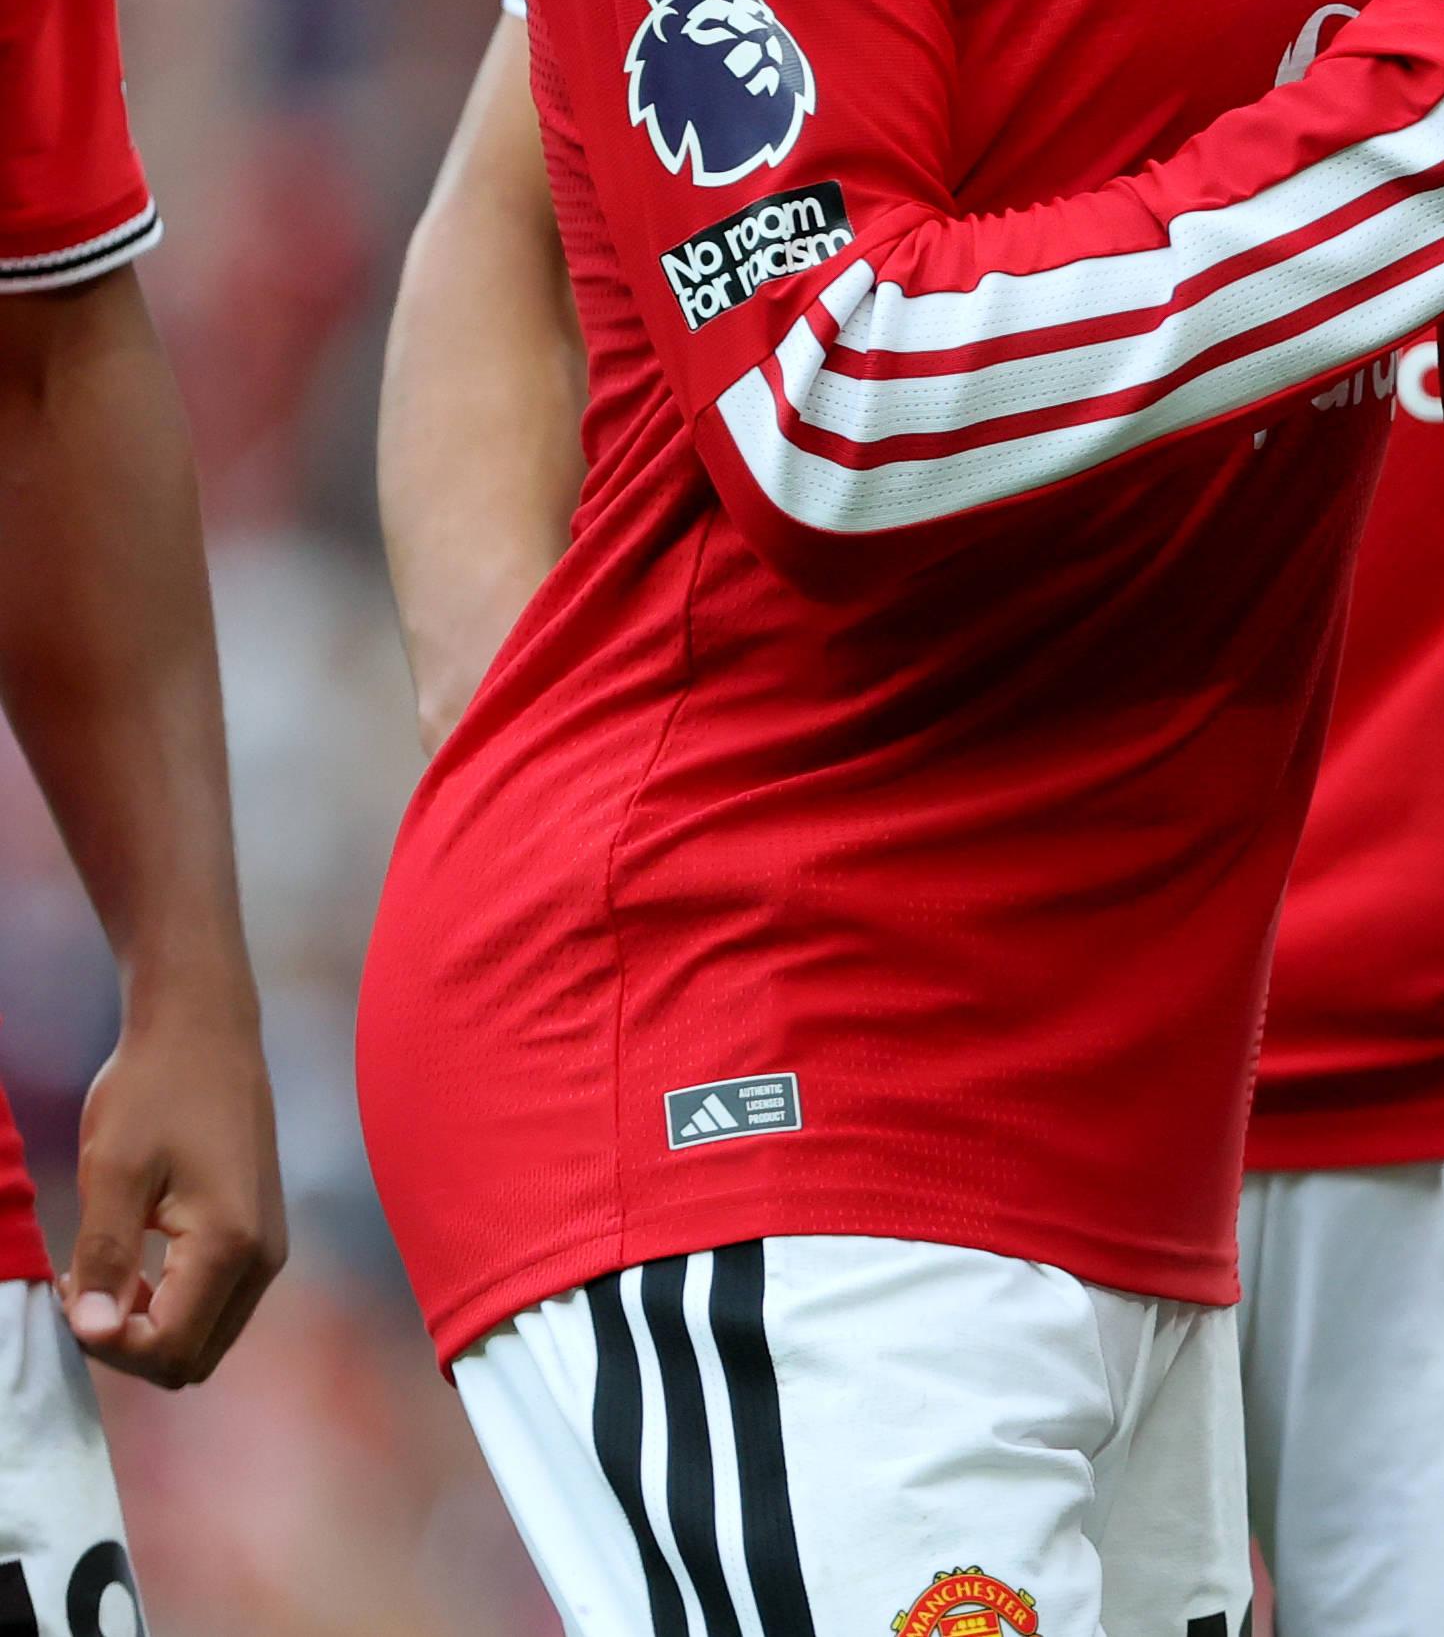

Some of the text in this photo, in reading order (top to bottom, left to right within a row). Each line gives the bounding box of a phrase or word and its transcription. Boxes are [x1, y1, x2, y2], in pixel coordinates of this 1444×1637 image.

[661, 196, 826, 296] No room
[678, 228, 853, 330] for racism
[738, 1083, 784, 1099] AUTHENTIC
[746, 1097, 785, 1111] LICENSED
[748, 1110, 787, 1125] PRODUCT
